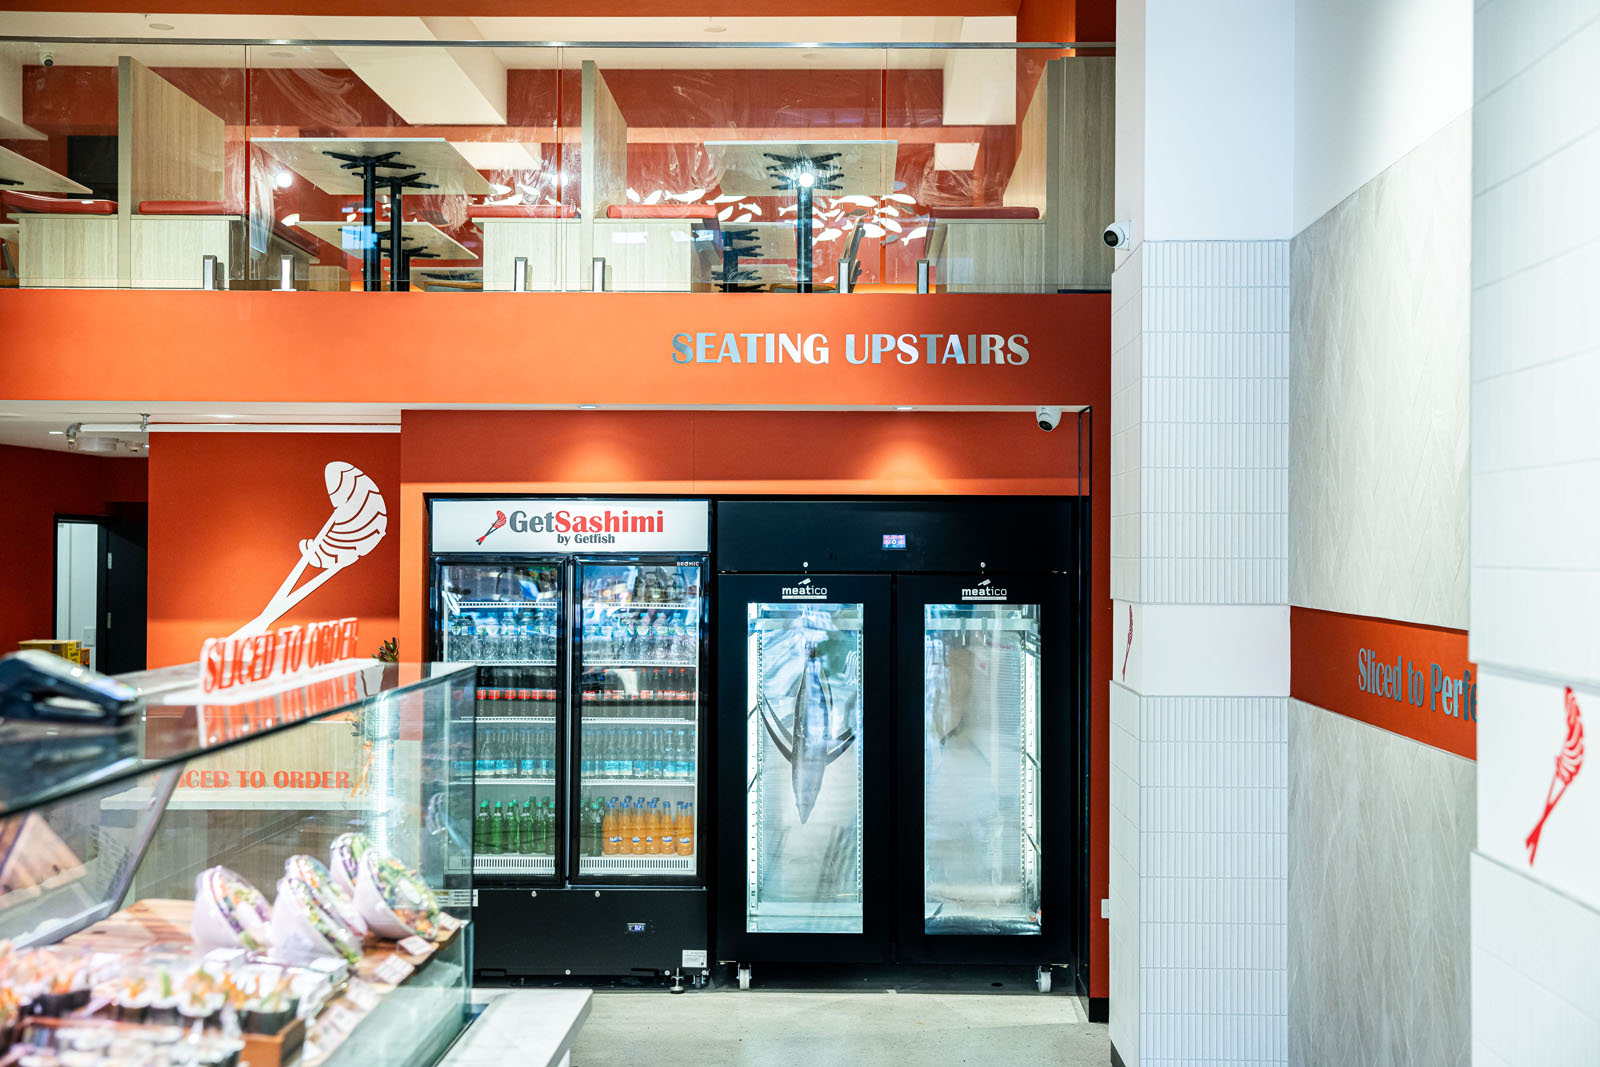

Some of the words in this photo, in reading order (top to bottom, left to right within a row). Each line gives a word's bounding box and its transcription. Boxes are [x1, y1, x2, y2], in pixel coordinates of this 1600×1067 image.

[671, 332, 830, 365] SEATING
[845, 333, 1030, 366] UPSTAIRS
[509, 510, 664, 533] GetSashimi
[557, 533, 570, 546] by
[574, 533, 616, 544] Getfish
[781, 585, 828, 596] meatico
[961, 586, 1008, 596] meatico
[202, 631, 277, 694] SLICED
[278, 627, 304, 675] TO
[1358, 647, 1403, 703] Sliced
[1407, 659, 1424, 707] to
[235, 770, 266, 789] TO
[273, 770, 350, 789] ORDER
